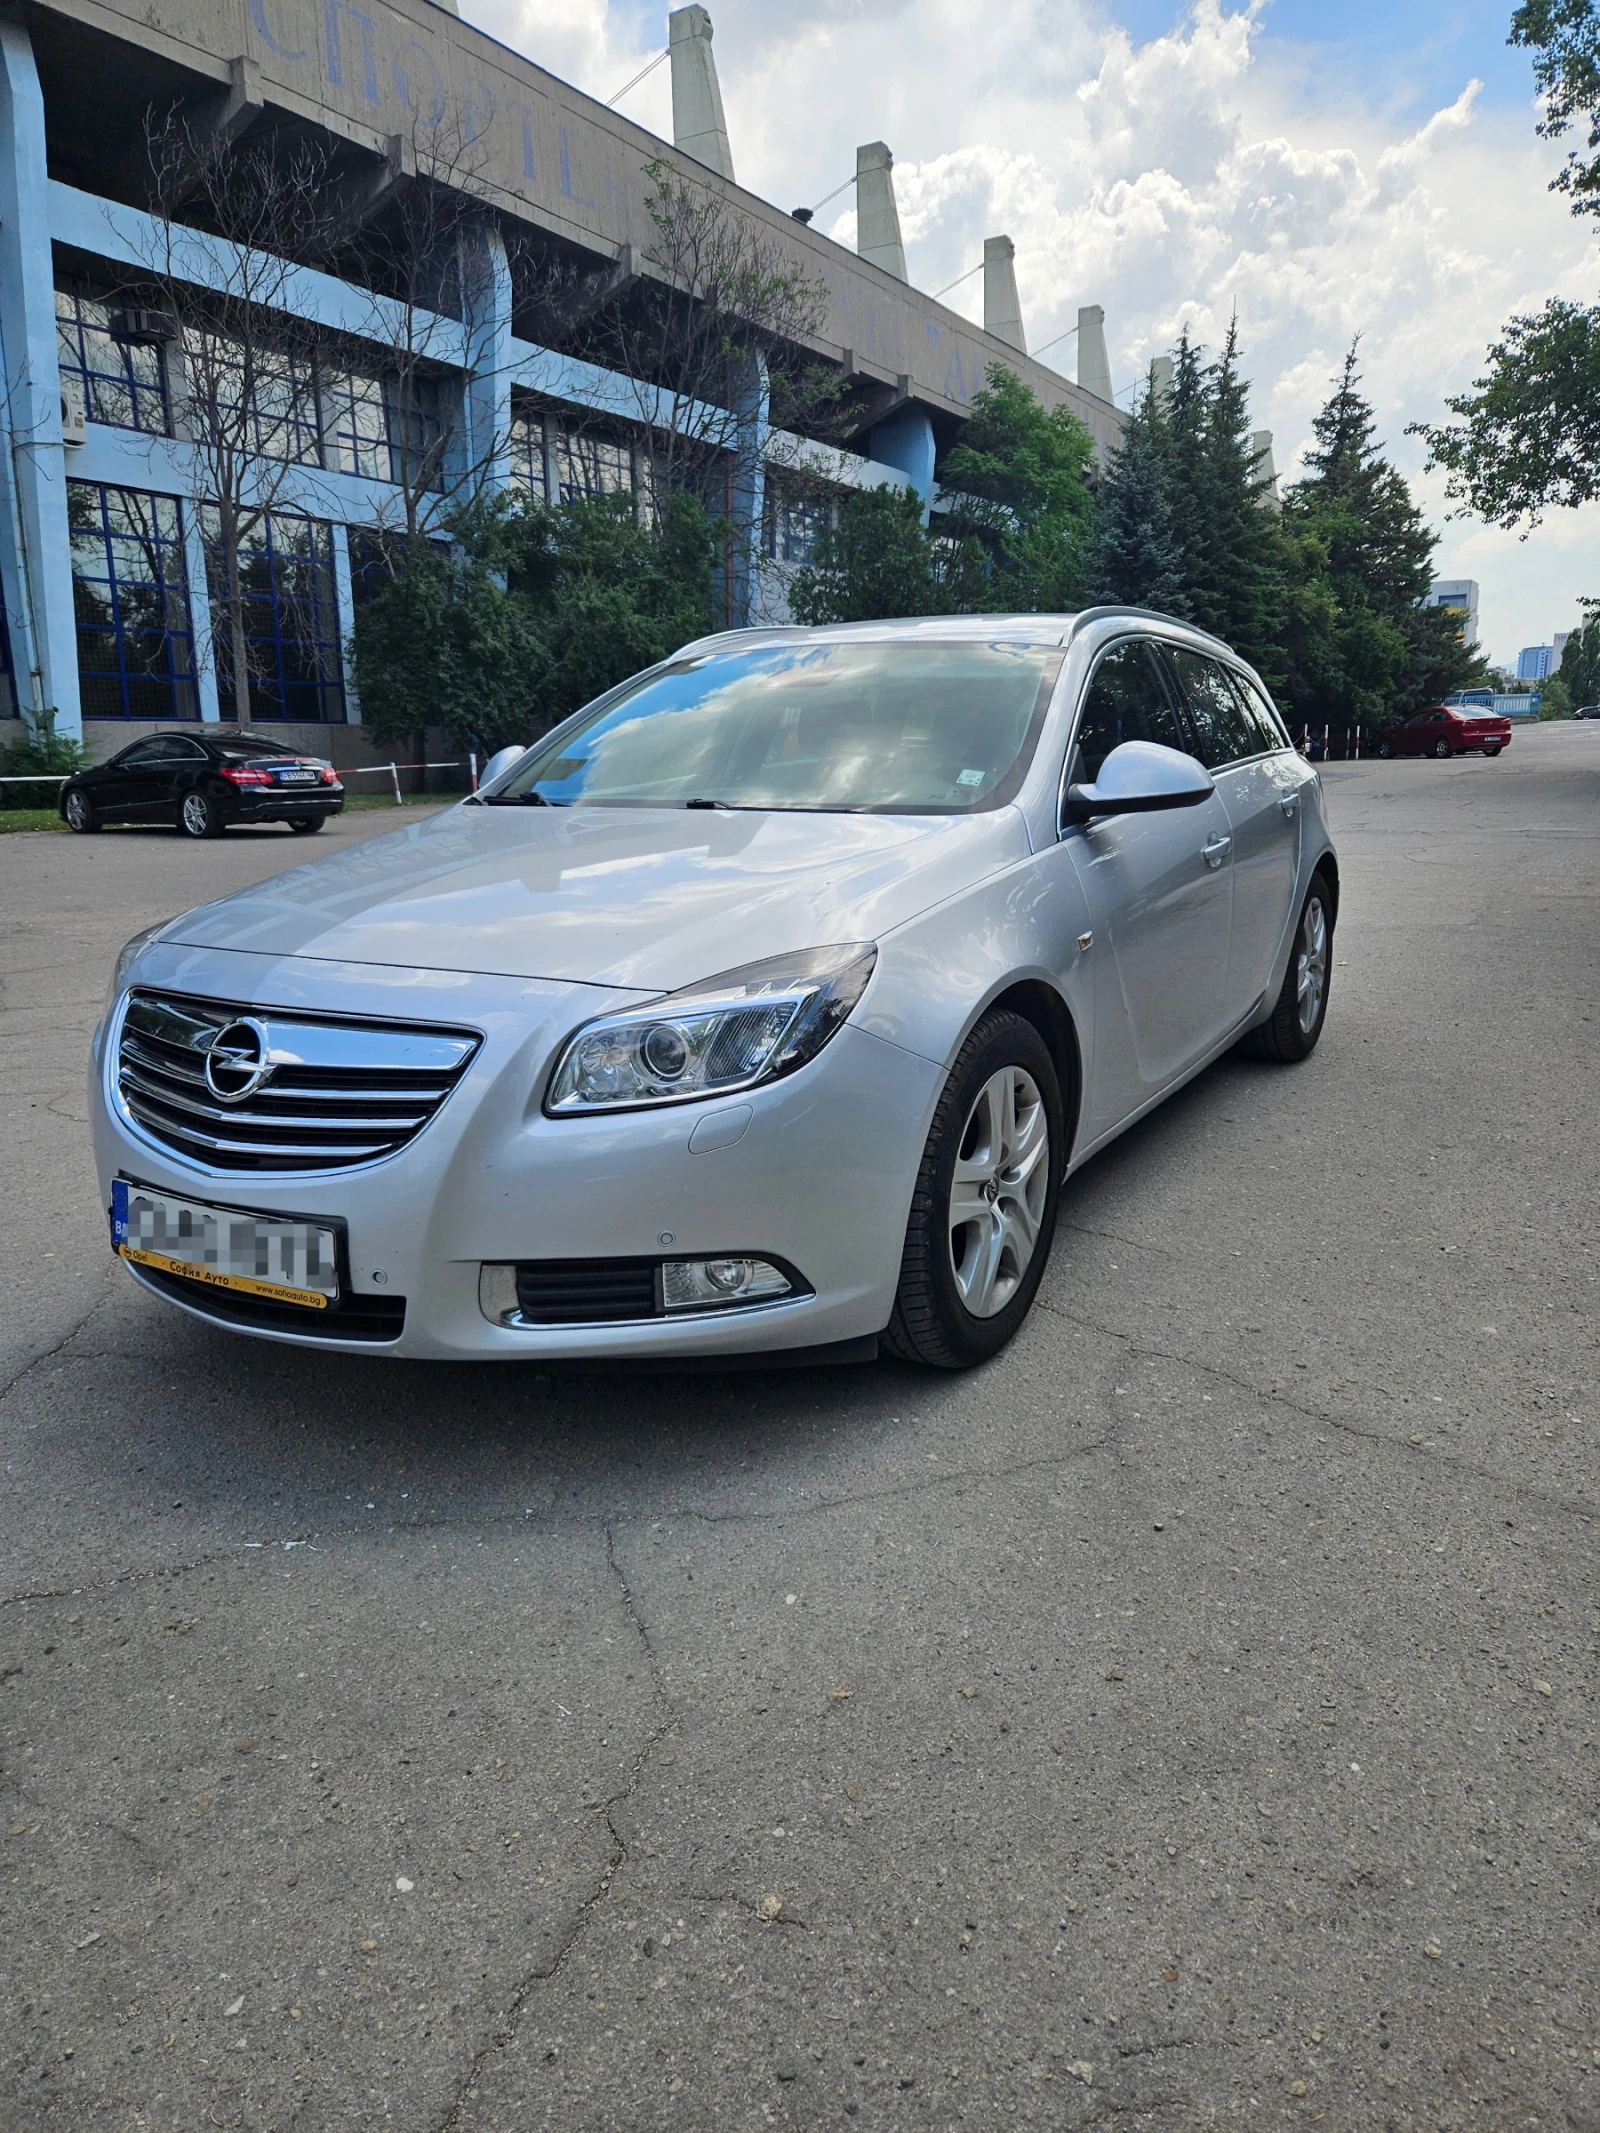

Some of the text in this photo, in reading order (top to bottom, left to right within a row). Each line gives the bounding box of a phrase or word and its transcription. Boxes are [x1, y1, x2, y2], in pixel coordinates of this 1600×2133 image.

[132, 1251, 148, 1262] Opel
[169, 1261, 229, 1285] София Ауто
[255, 1284, 321, 1306] www.sofiaauto.bg
